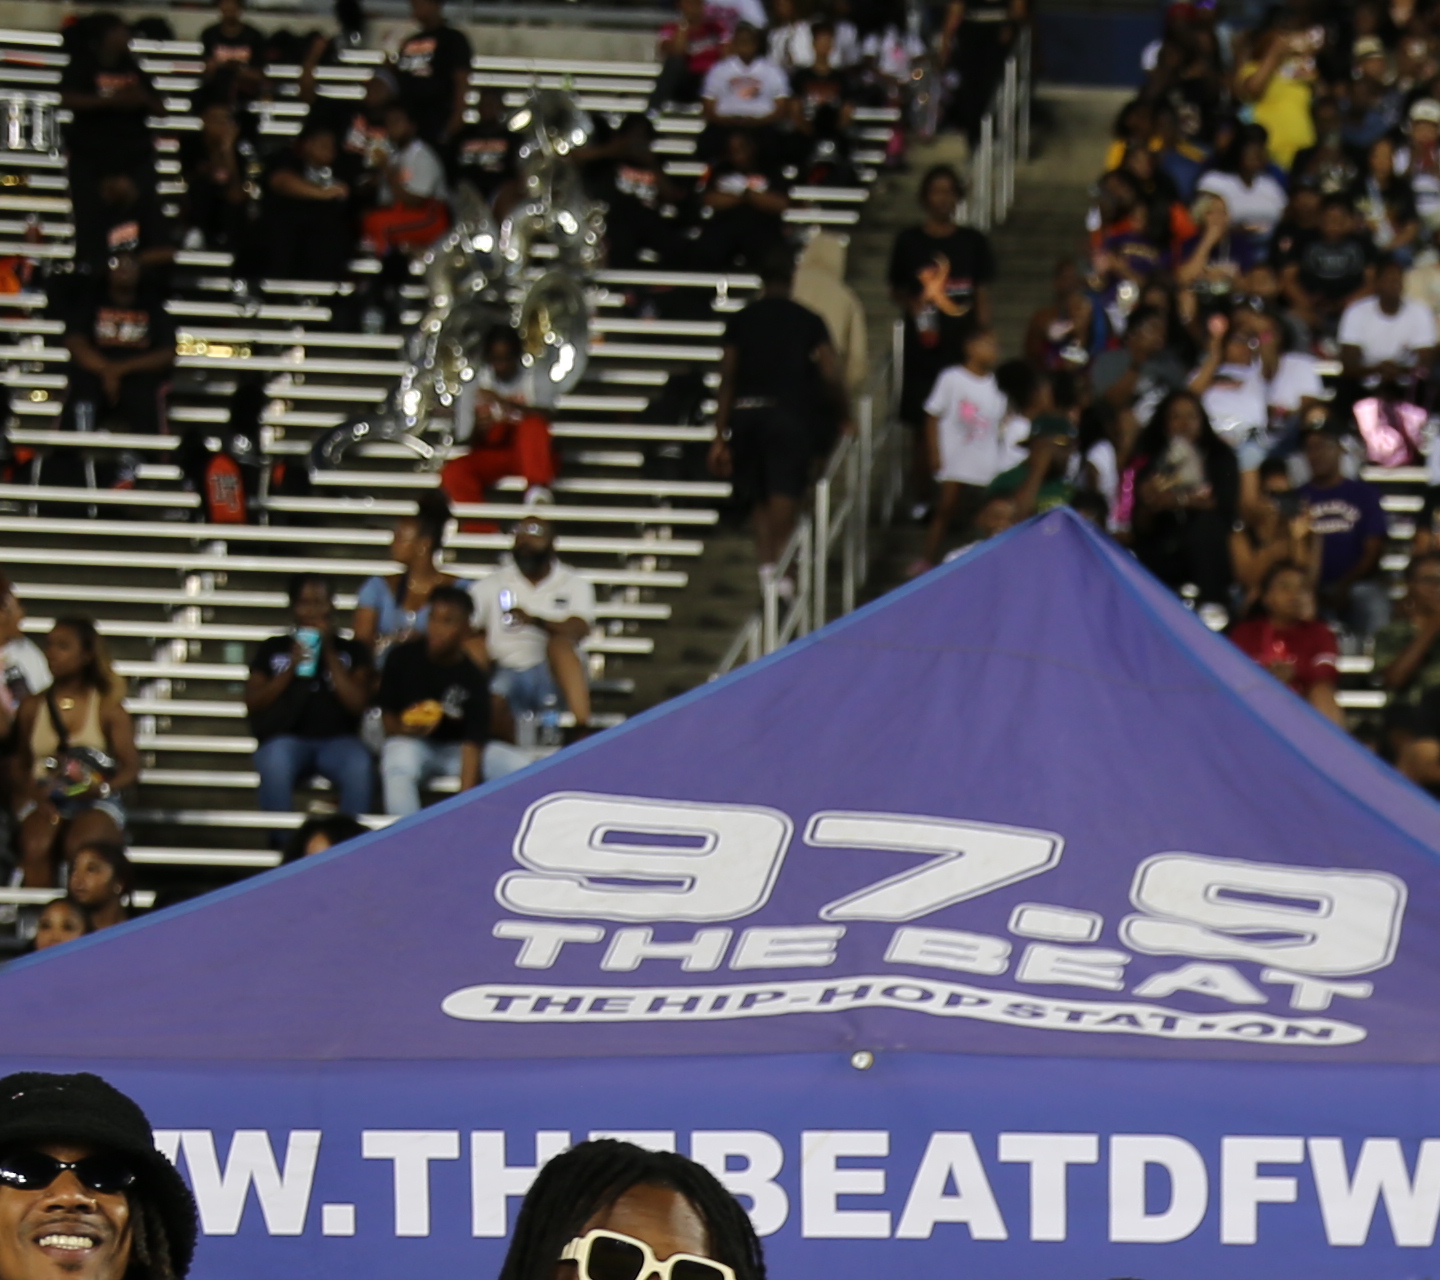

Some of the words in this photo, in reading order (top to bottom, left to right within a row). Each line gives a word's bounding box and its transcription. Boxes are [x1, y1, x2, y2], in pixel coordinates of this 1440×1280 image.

[494, 790, 1407, 976] 97.9
[492, 920, 845, 972] THE
[885, 927, 1373, 1011] BEAT
[484, 993, 636, 1014] THE
[1001, 1001, 1337, 1039] STATION
